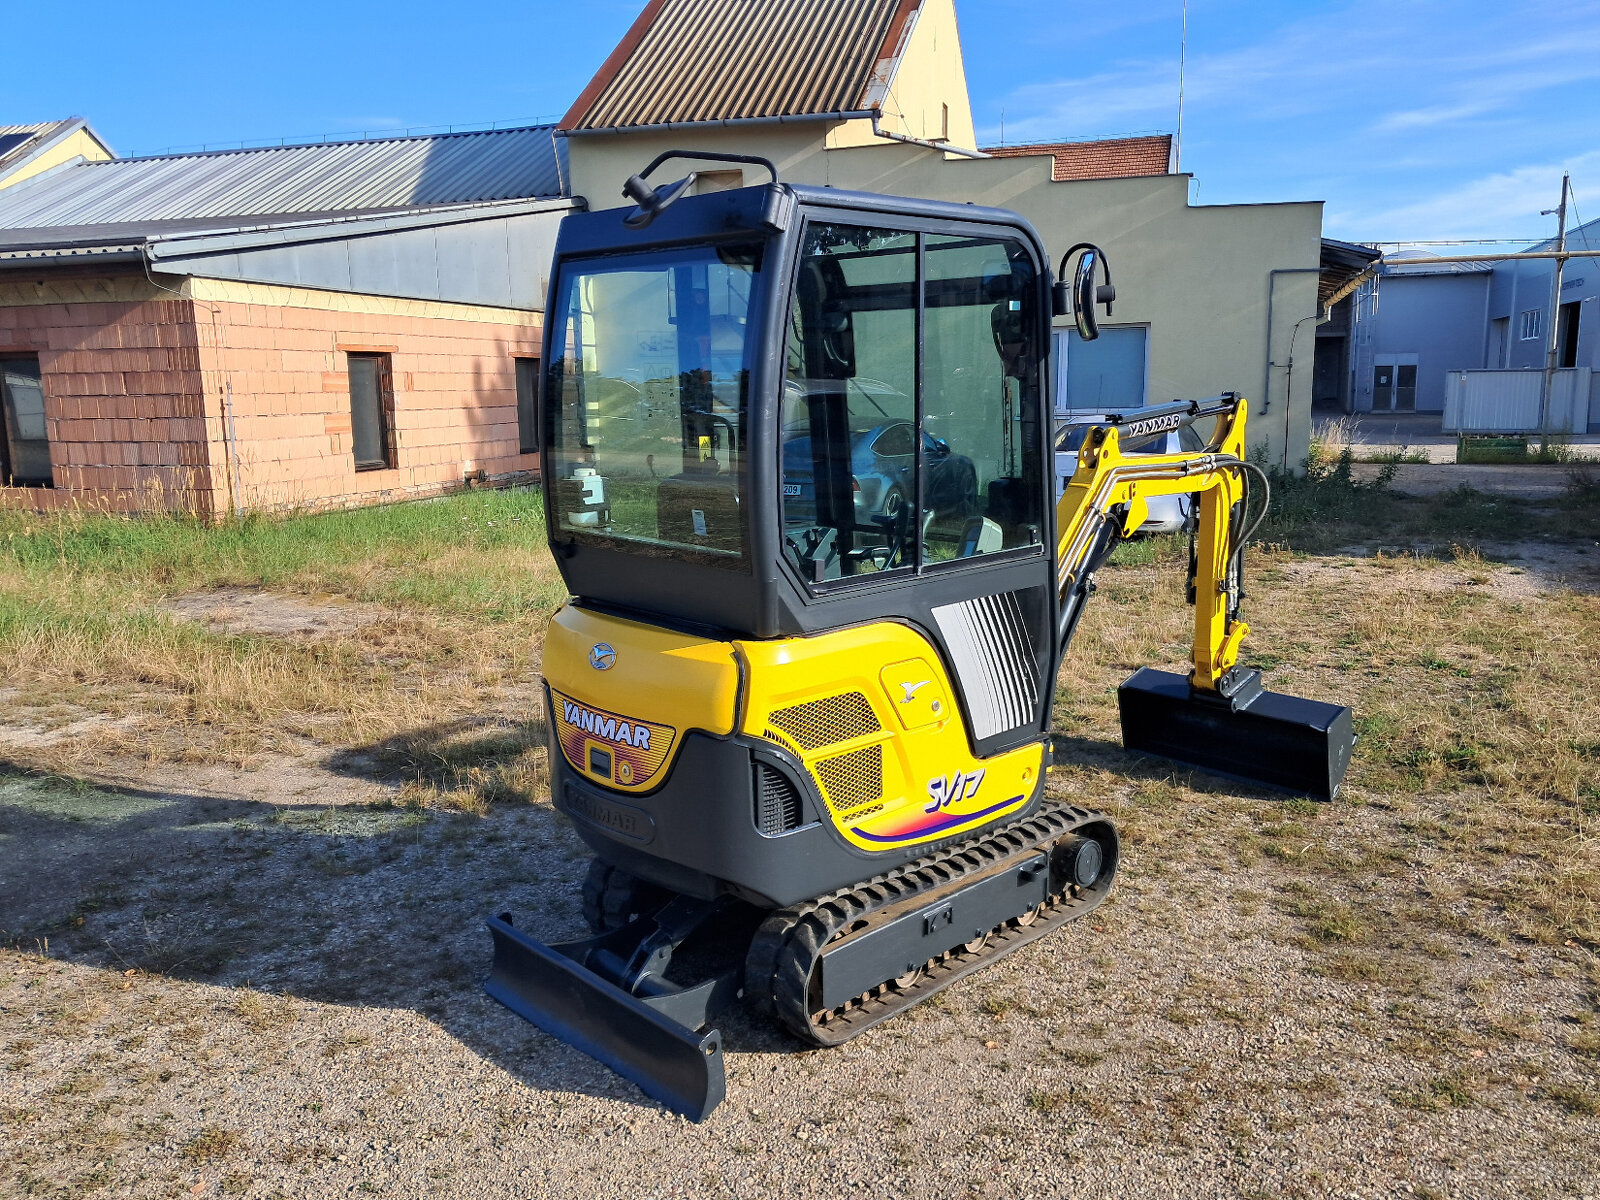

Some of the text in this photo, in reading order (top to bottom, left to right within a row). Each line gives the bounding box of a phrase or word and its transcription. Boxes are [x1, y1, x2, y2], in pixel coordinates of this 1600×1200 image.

[1128, 413, 1181, 438] YANMAR
[562, 699, 652, 750] YANMAR
[923, 768, 986, 814] SV17
